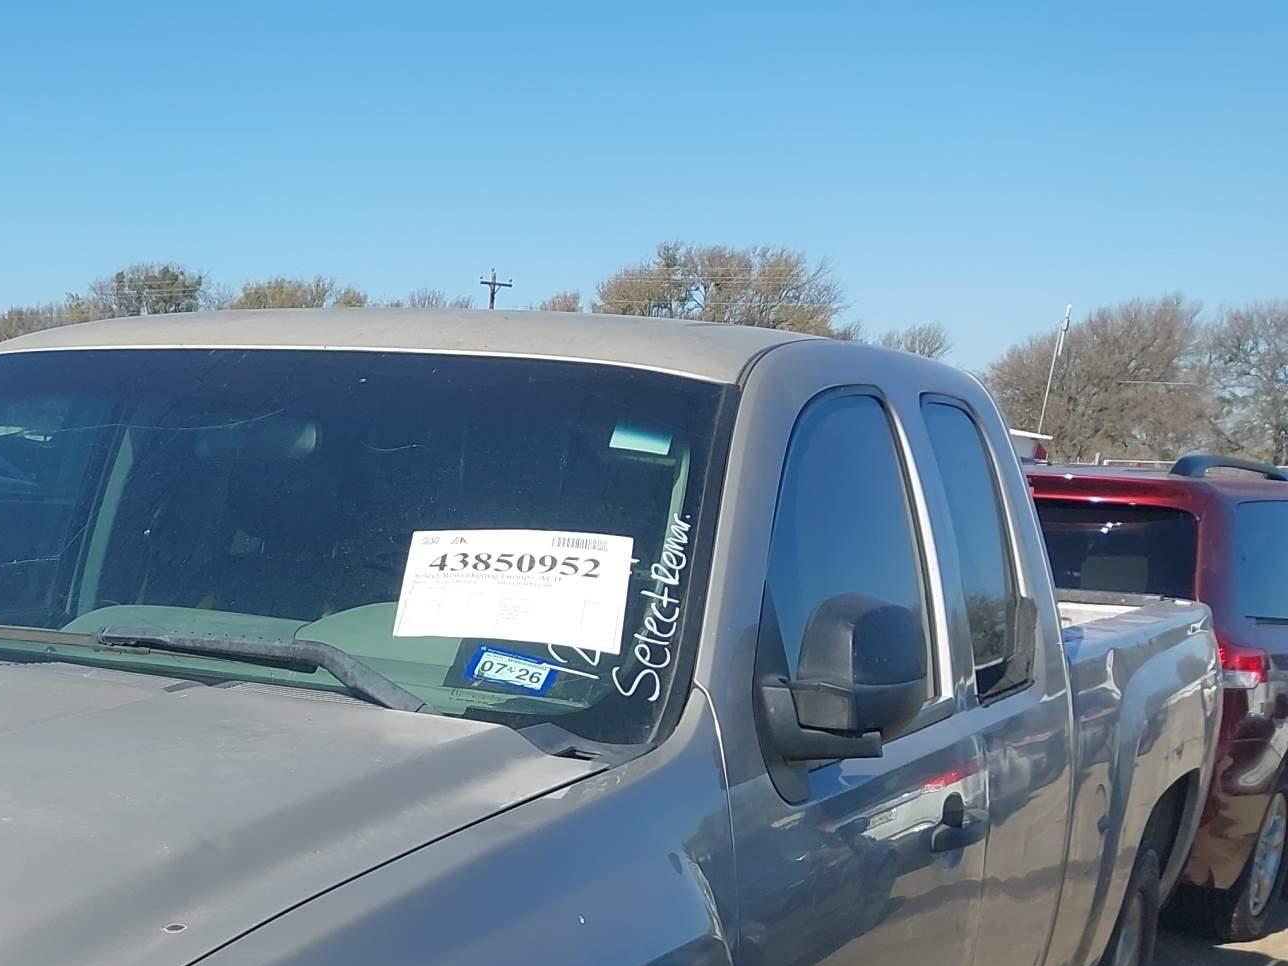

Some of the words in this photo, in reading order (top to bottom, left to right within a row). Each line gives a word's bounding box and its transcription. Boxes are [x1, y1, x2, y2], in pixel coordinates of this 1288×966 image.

[429, 552, 601, 578] 43850952
[612, 586, 680, 702] Select
[480, 660, 508, 674] 07
[515, 668, 543, 684] 26
